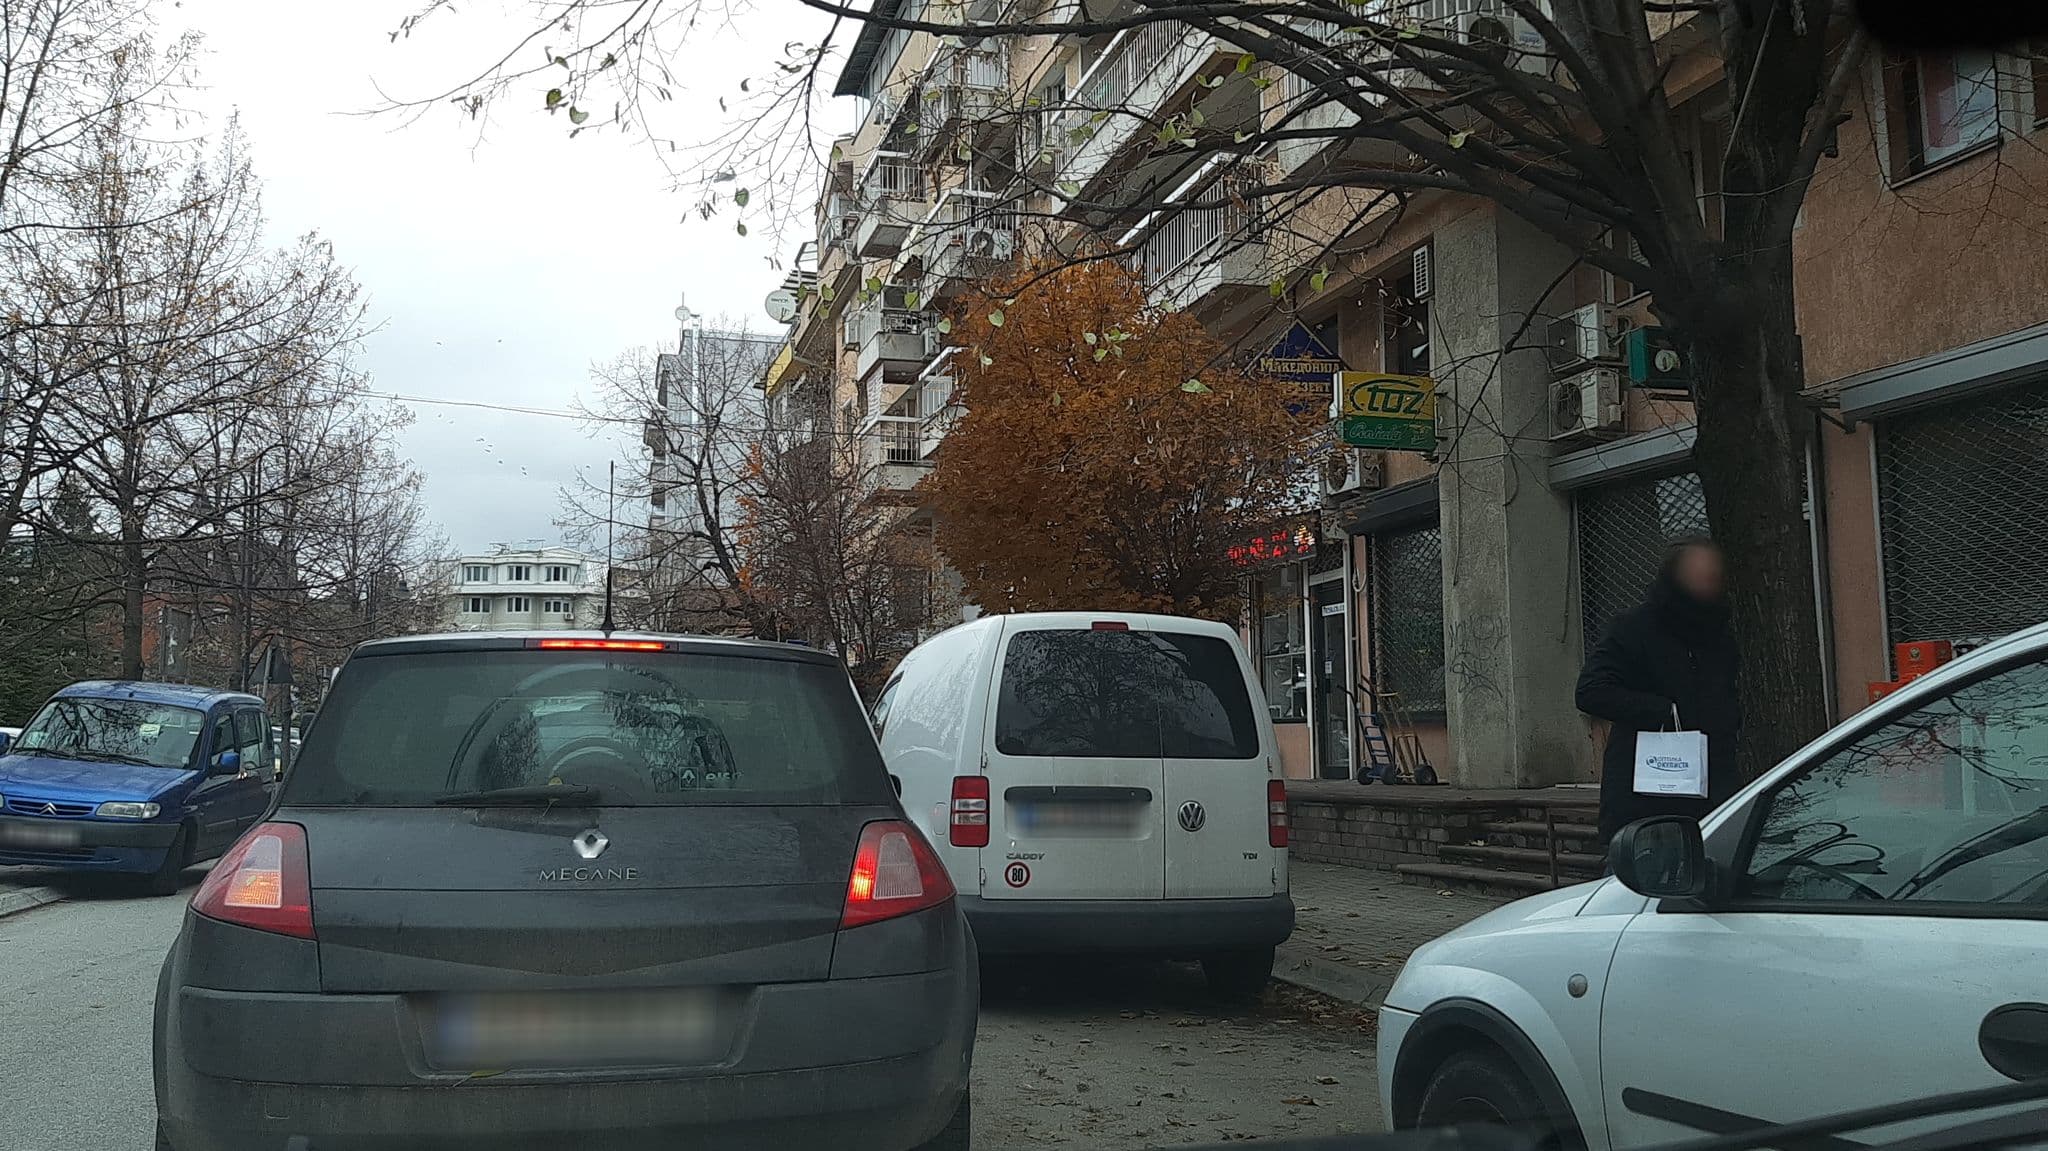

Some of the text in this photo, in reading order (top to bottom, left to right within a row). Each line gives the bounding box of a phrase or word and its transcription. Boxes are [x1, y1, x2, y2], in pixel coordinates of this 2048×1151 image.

[1006, 852, 1045, 860] CADDY
[1242, 852, 1258, 860] TDI
[540, 867, 638, 881] MEGANE
[1012, 867, 1024, 882] 80
